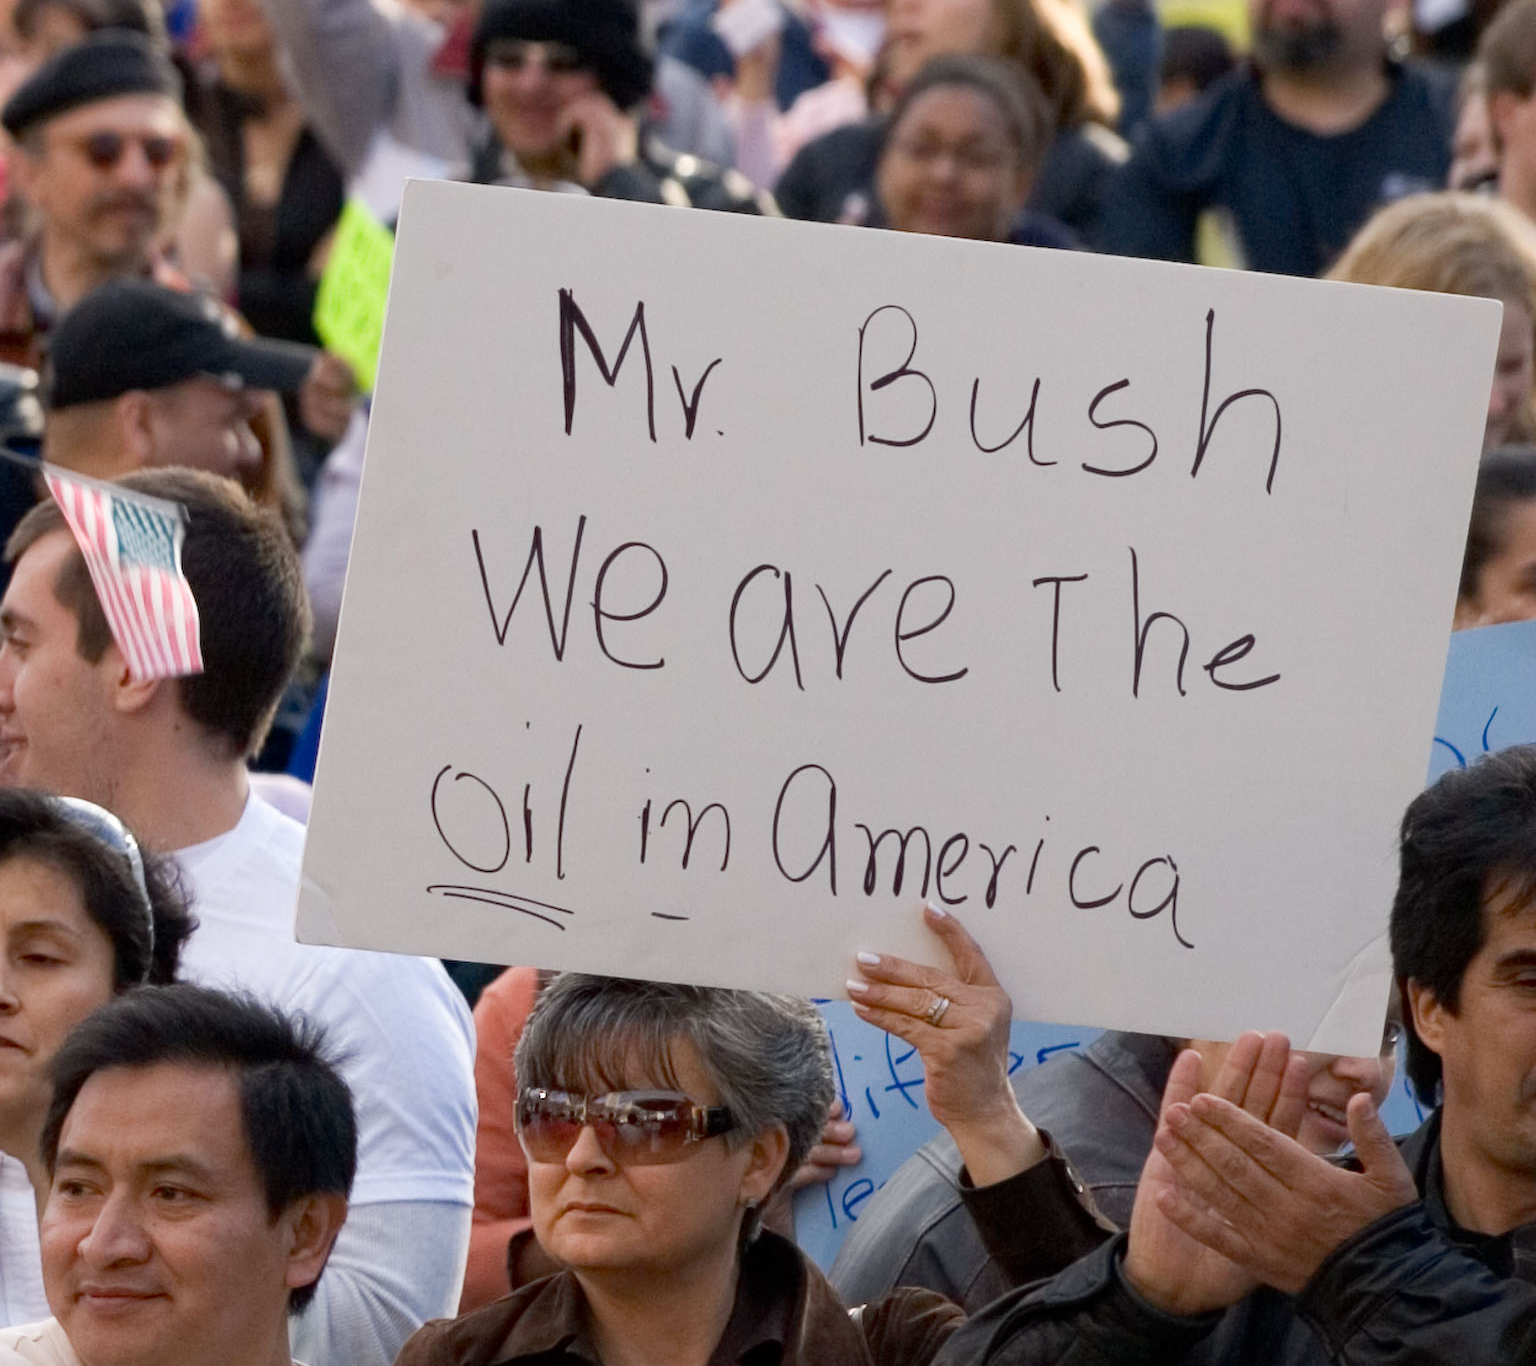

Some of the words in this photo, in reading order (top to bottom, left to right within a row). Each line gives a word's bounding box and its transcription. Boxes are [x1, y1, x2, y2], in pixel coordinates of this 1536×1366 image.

[559, 288, 721, 443] Mr.
[858, 306, 1281, 494] Bush
[472, 515, 667, 669] We
[730, 565, 968, 690] are
[1033, 548, 1280, 698] The
[641, 767, 730, 871] in
